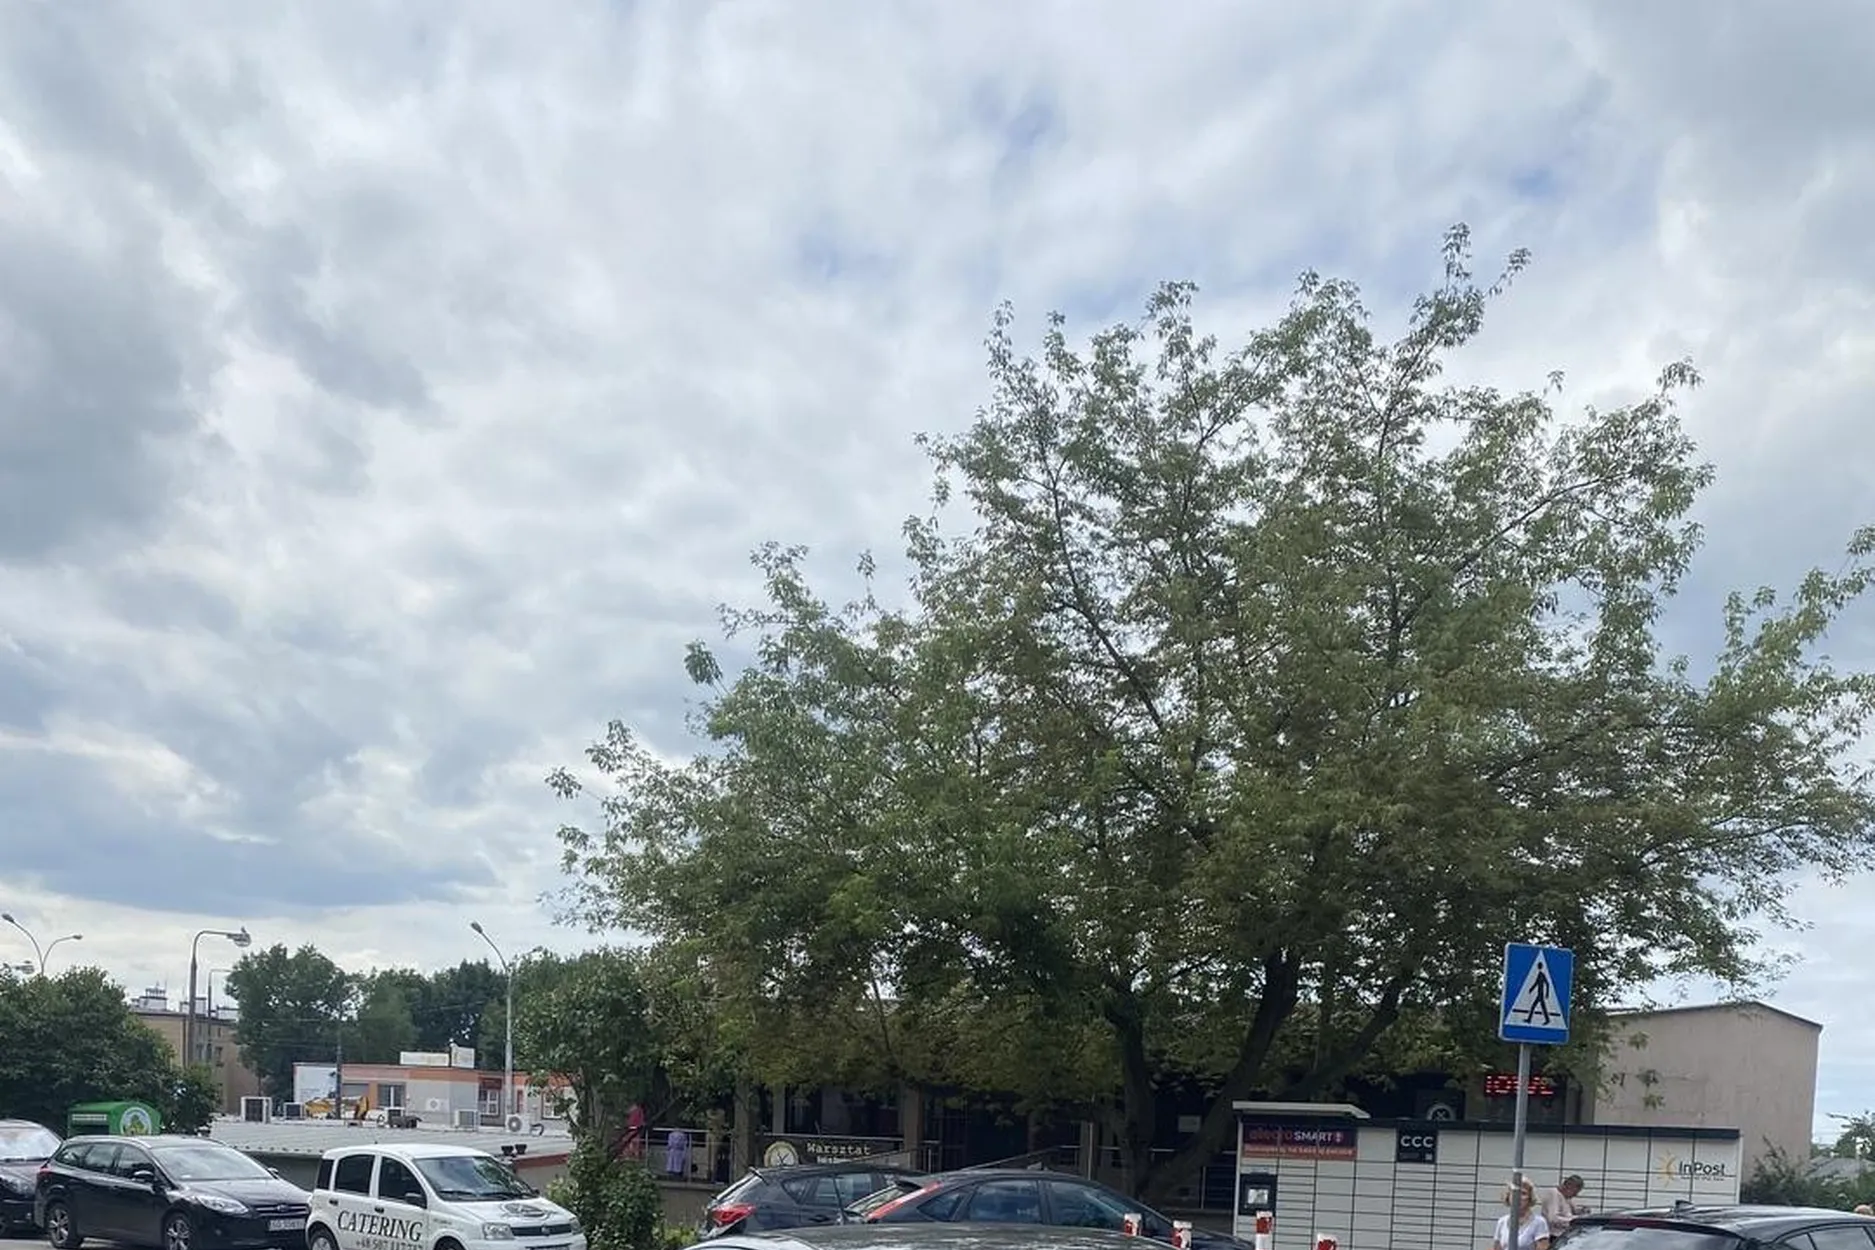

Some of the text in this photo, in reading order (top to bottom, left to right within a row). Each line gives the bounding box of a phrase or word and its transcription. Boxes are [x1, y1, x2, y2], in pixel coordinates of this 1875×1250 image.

[1400, 1135, 1434, 1148] CCC
[1679, 1161, 1725, 1176] InPost
[338, 1210, 423, 1242] CATERING
